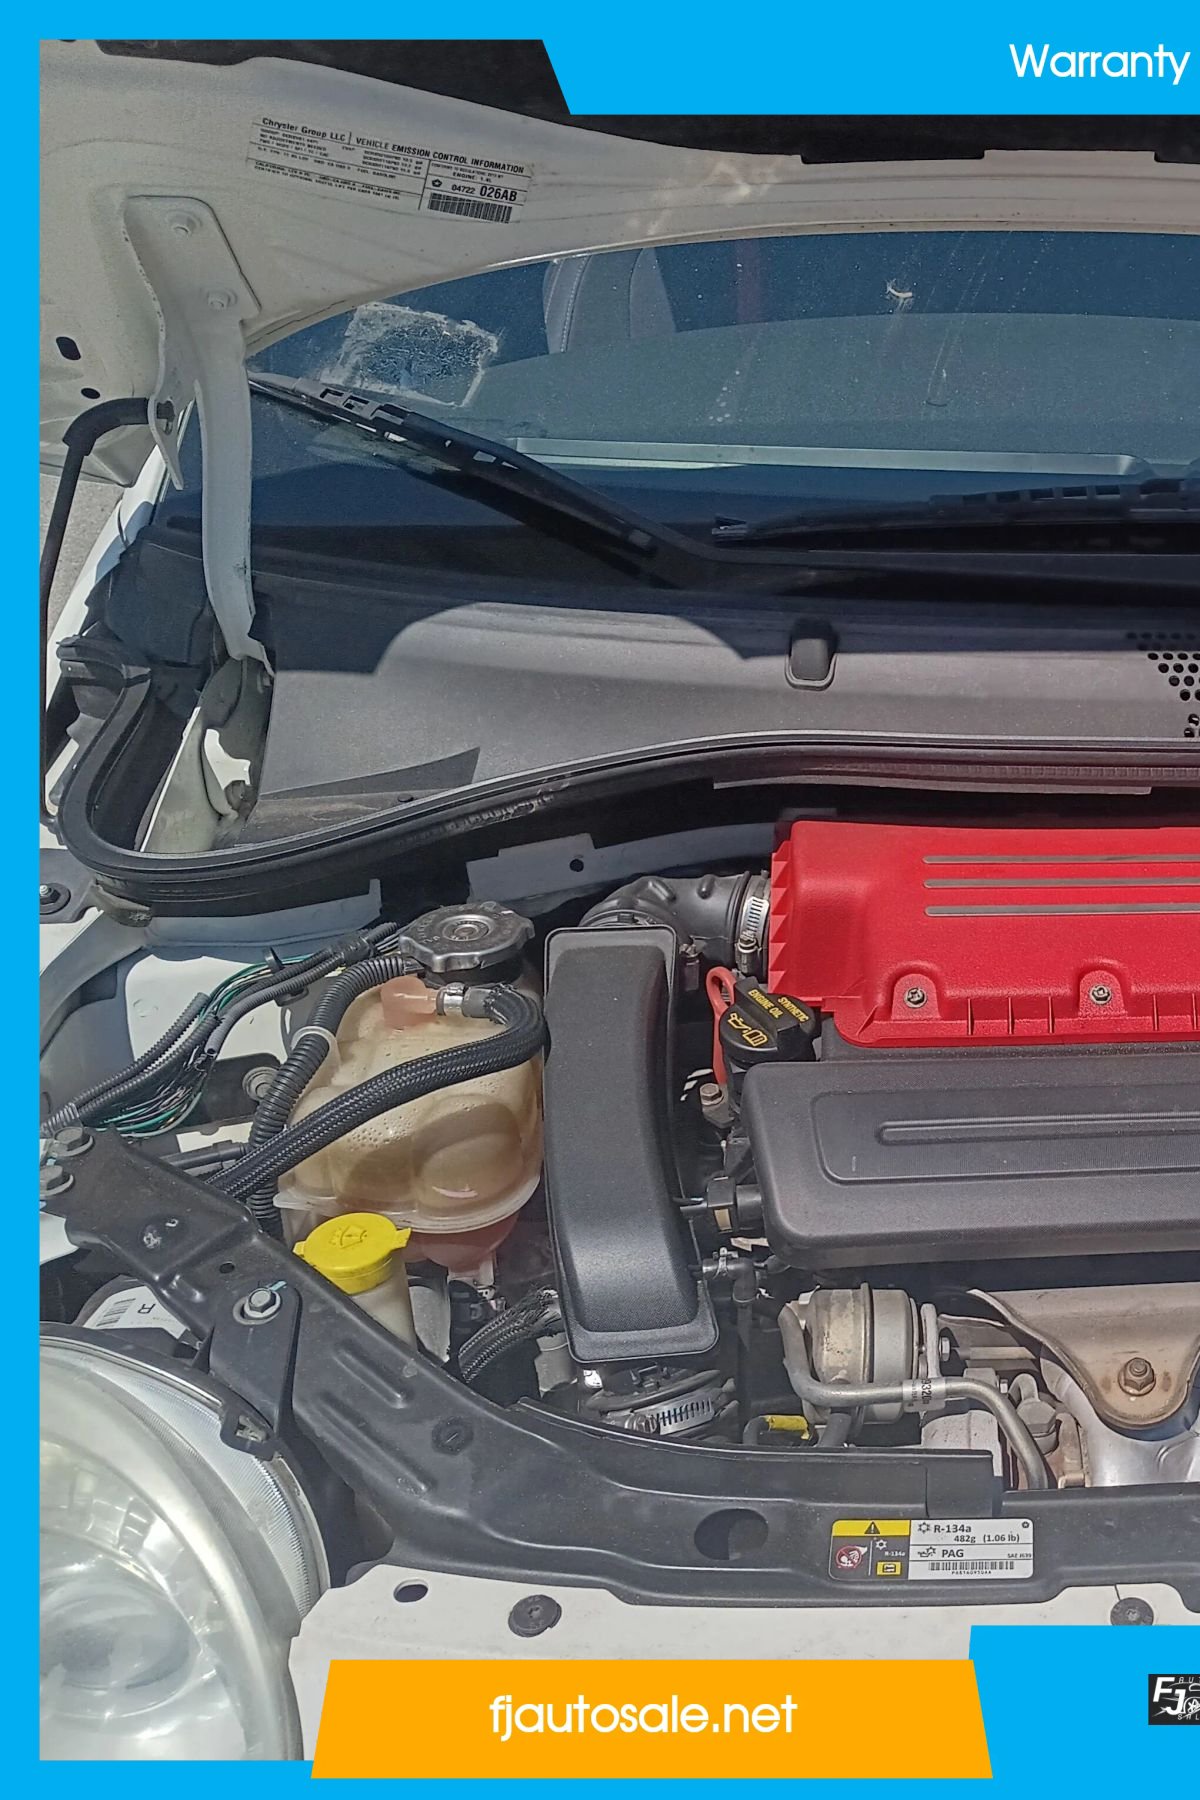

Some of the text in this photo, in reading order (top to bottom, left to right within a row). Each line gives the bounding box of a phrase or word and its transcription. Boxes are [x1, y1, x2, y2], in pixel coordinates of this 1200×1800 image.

[262, 116, 299, 133] Chrysler
[300, 125, 328, 141] Group
[329, 131, 346, 142] LLC
[355, 136, 388, 151] VEHICLE
[391, 144, 430, 158] EMISSION
[432, 152, 468, 165] CONTROL
[471, 158, 525, 174] INFORMATION
[451, 184, 518, 202] 04722 026AB
[748, 988, 784, 1019] ENGINE OIL
[778, 997, 809, 1022] SYNTHETIC
[138, 1303, 156, 1315] R
[933, 1524, 972, 1534] R-134a
[953, 1533, 1020, 1544] 482g (1.06 lb)
[941, 1549, 964, 1558] PAG
